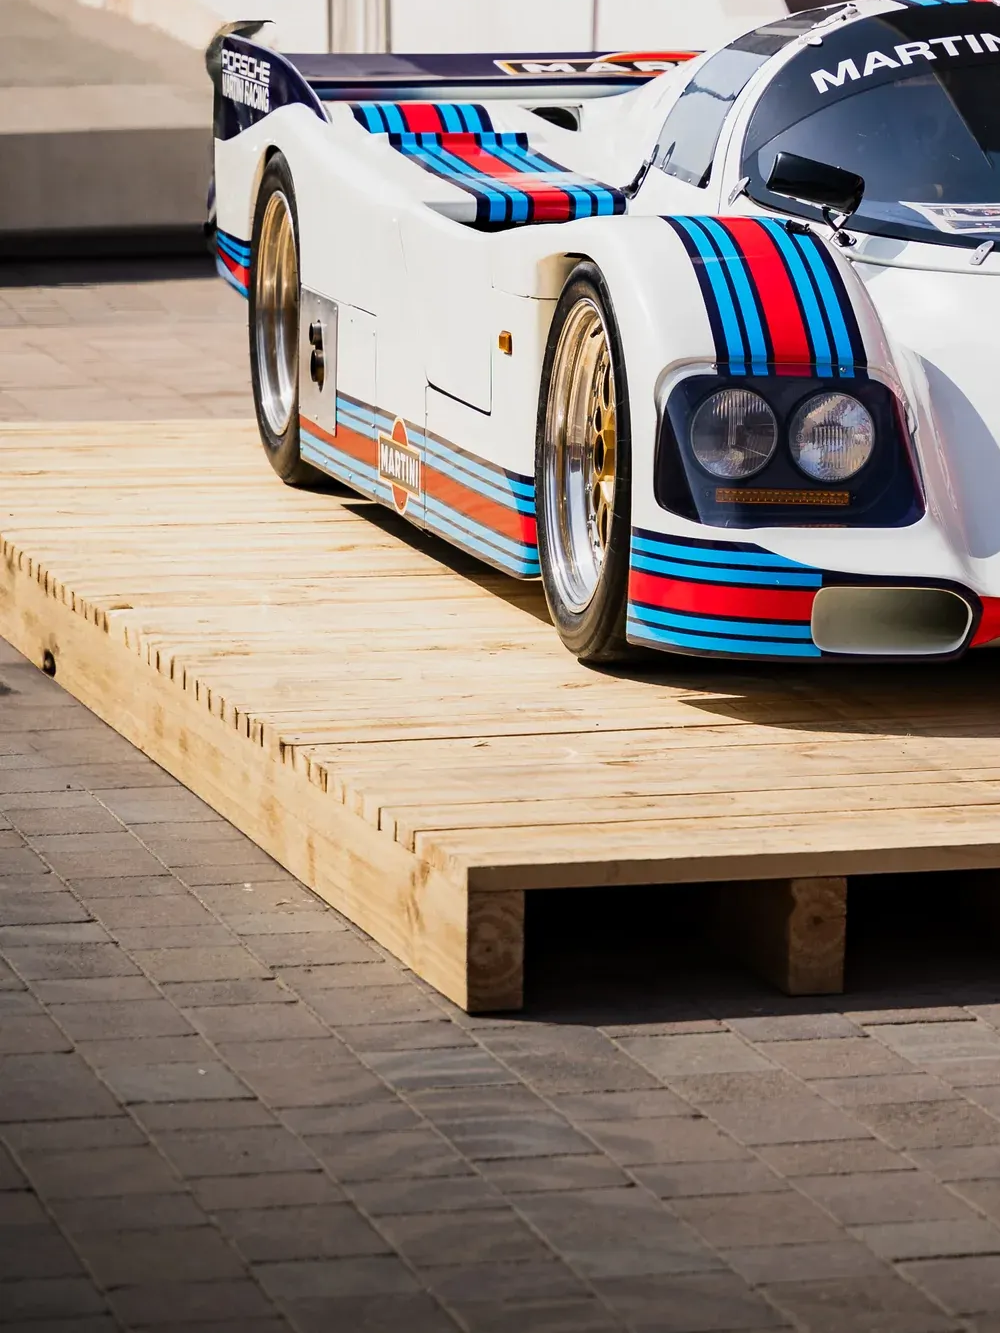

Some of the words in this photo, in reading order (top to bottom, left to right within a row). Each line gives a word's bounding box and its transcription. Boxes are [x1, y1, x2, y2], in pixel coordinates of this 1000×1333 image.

[222, 49, 270, 83] PORSCHE
[222, 73, 244, 103] MARTINI
[245, 80, 269, 113] RACING
[381, 443, 419, 489] MARTINI
